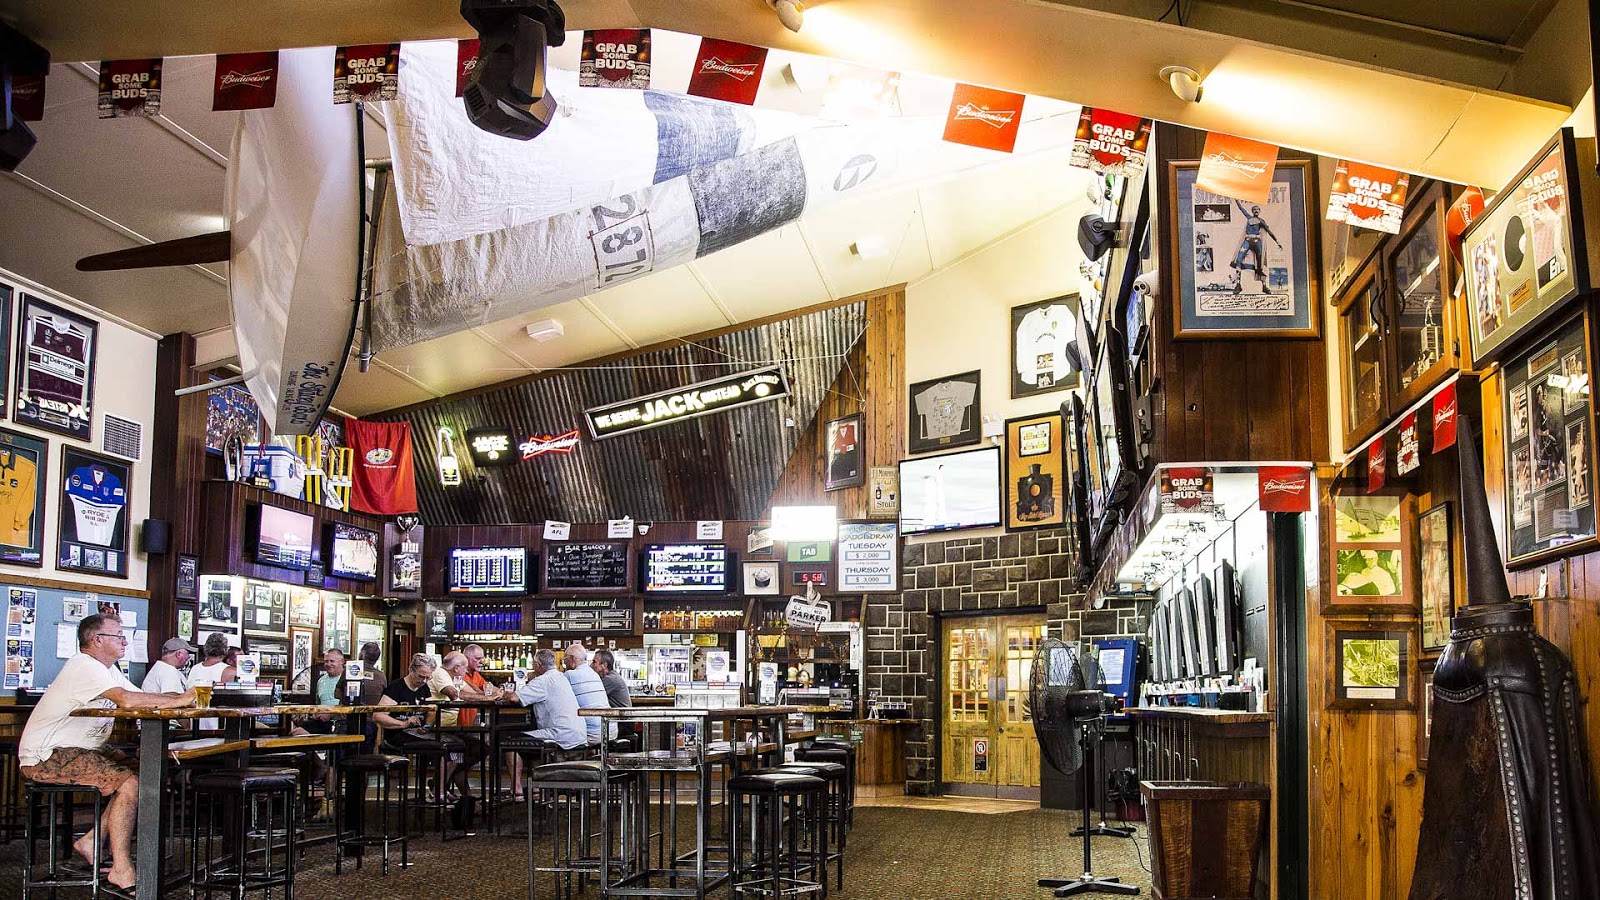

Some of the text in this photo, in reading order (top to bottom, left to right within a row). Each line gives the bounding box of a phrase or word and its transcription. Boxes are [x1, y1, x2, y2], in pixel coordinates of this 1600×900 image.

[595, 42, 637, 54] GRAB
[348, 57, 386, 69] GRAB
[595, 58, 636, 70] BUDS
[702, 59, 755, 77] Budweiser
[354, 67, 379, 75] SOME
[112, 73, 150, 84] GRAB
[220, 74, 271, 85] Budweiser
[348, 72, 384, 85] BUDS
[112, 88, 148, 99] BUDS
[956, 104, 1011, 124] Budweiser
[1092, 123, 1135, 141] GRAB
[1098, 134, 1126, 146] SOME
[1089, 139, 1131, 157] BUDS
[1208, 153, 1265, 174] Budweiser
[1348, 176, 1392, 194] GRAB
[1346, 192, 1389, 211] BUDS
[595, 414, 612, 429] WE
[641, 390, 706, 422] JACK
[520, 438, 579, 454] Budweiser
[1171, 478, 1203, 488] GRAB
[1264, 481, 1304, 492] Budweiser
[1172, 490, 1204, 500] BUDS
[565, 545, 581, 554] BAR
[801, 547, 817, 556] TAB
[791, 610, 827, 622] PARKER
